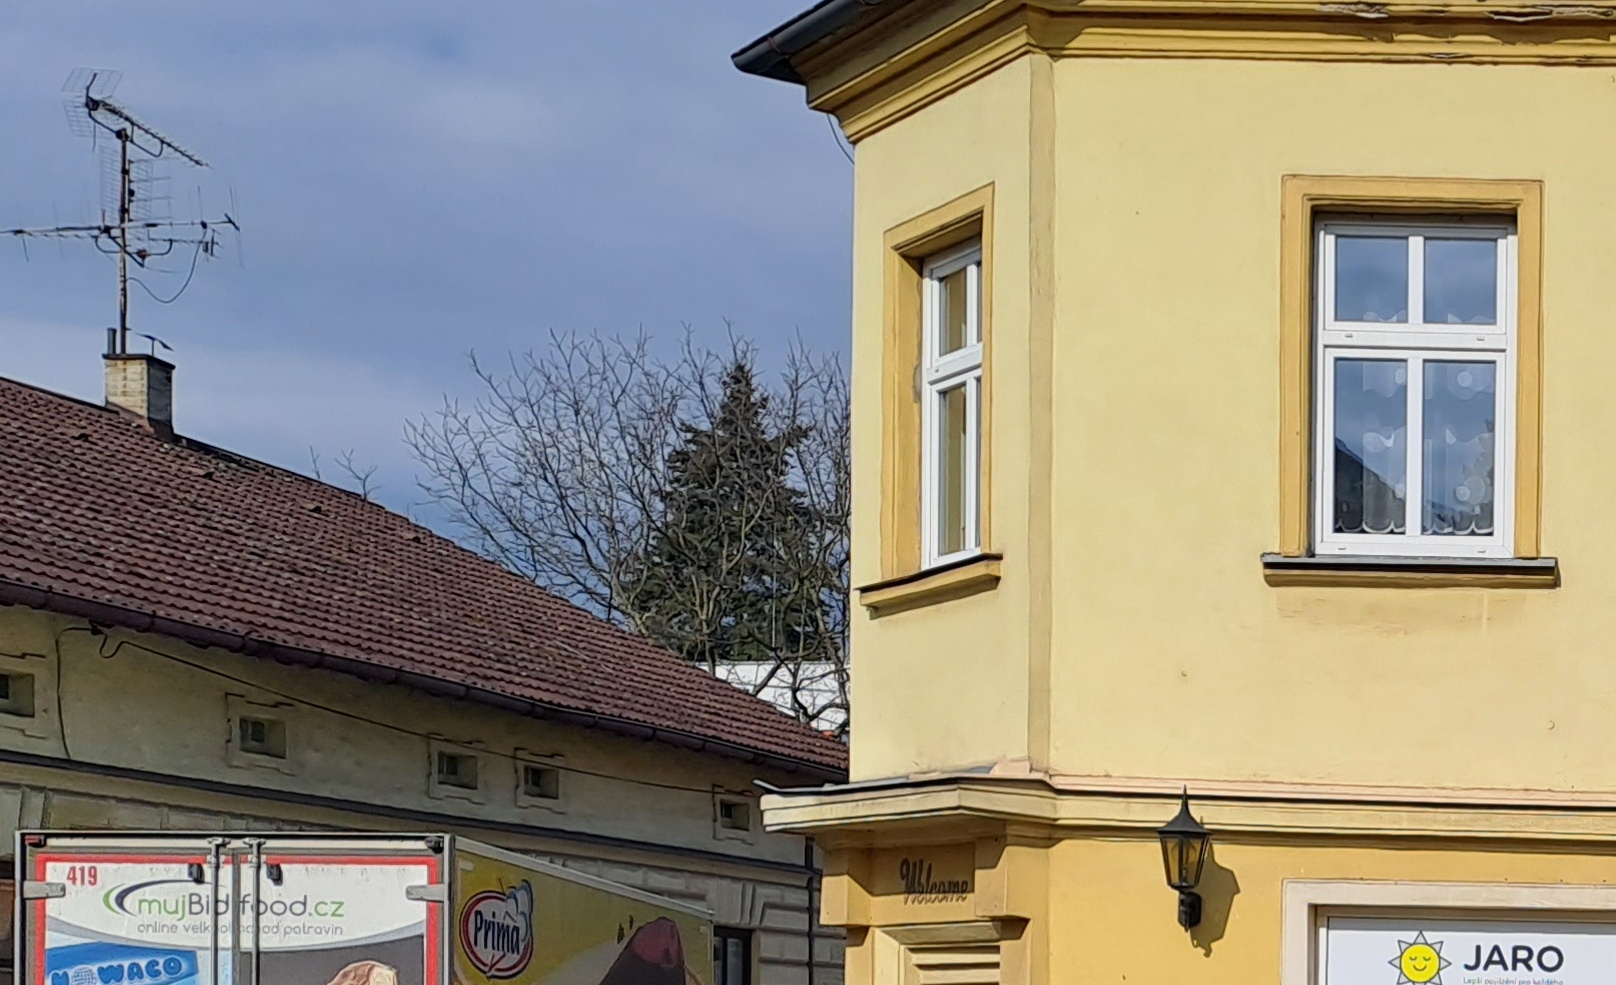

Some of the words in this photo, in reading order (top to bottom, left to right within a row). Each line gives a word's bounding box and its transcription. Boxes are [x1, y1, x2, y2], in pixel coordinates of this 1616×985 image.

[66, 865, 98, 886] 419
[137, 922, 178, 934] online
[473, 909, 520, 955] Prima
[1463, 944, 1564, 973] JARO
